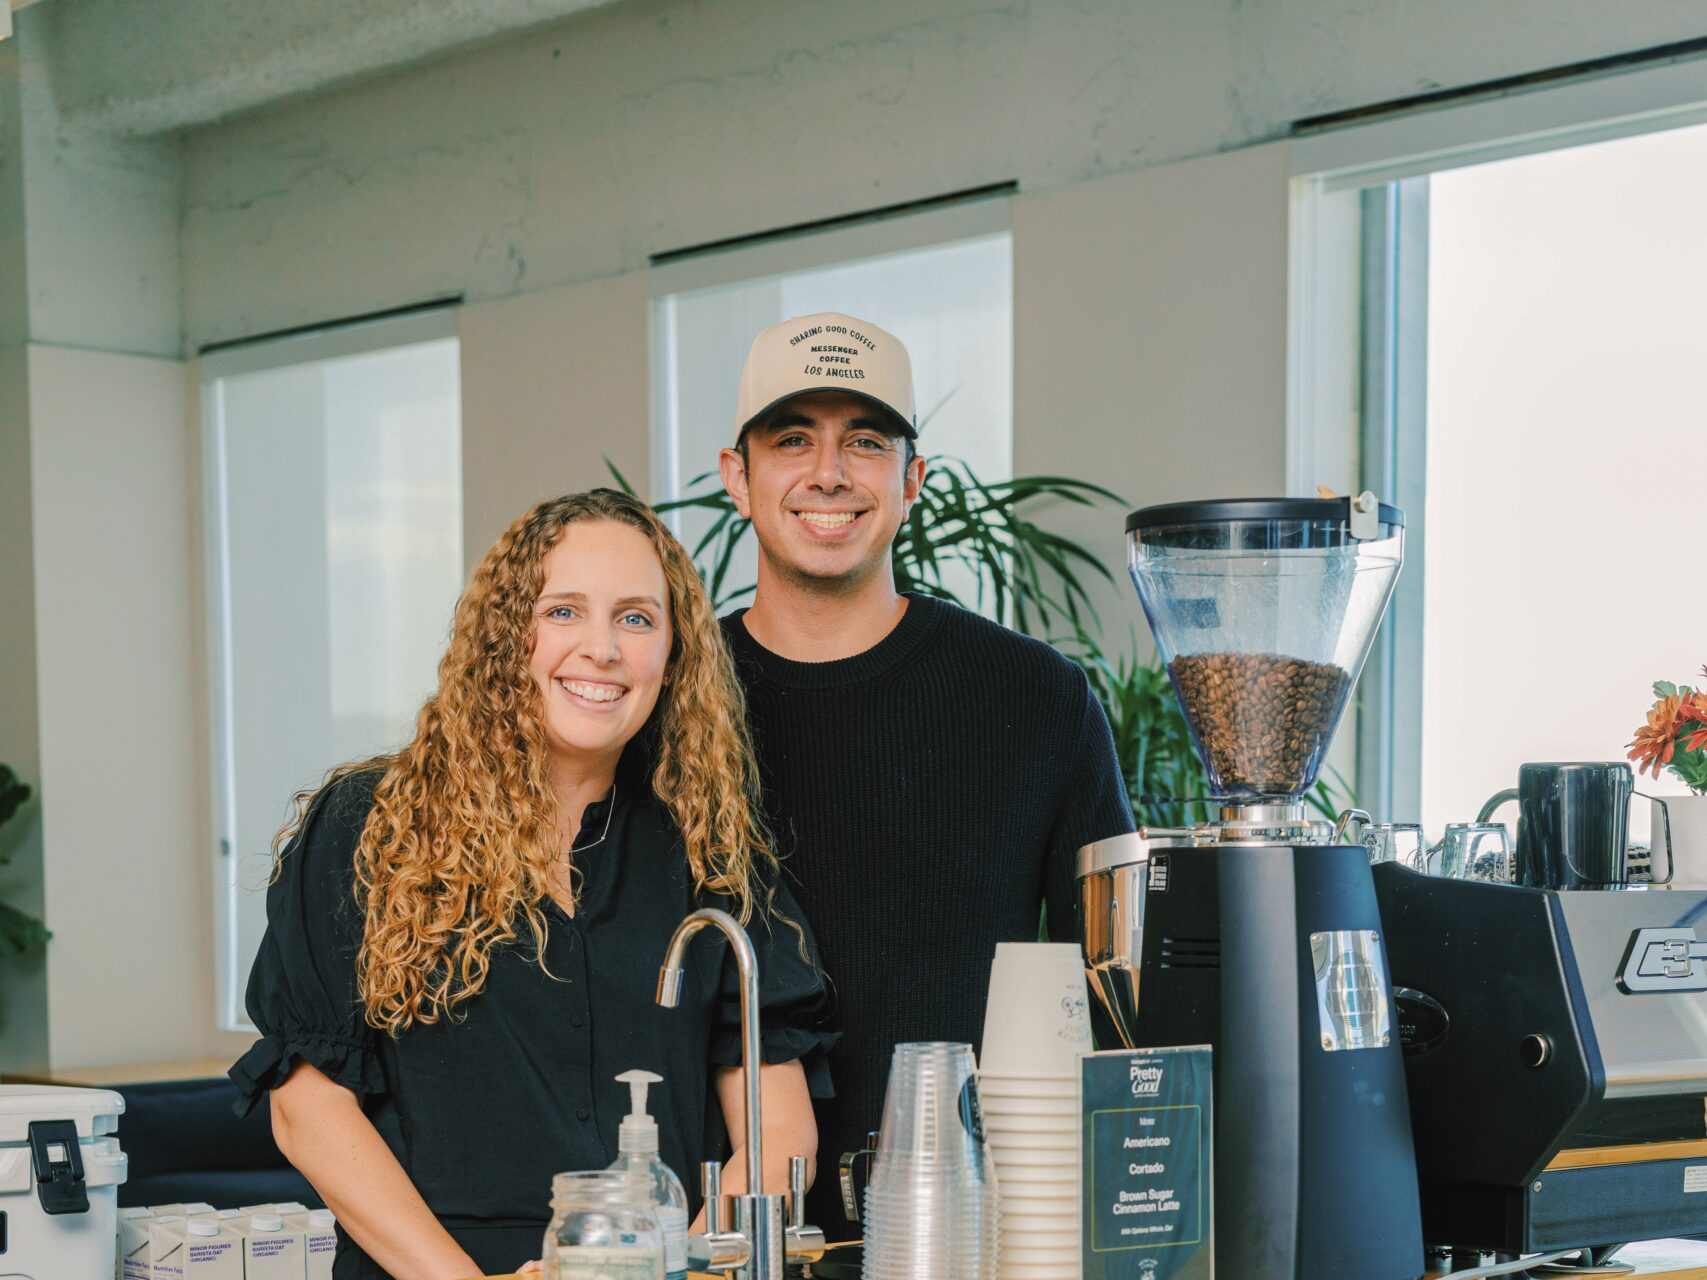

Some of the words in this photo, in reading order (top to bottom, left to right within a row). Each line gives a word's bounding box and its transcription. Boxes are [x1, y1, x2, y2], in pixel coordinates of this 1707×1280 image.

[789, 326, 823, 347] SHARING
[825, 325, 847, 335] GOOD
[849, 329, 877, 352] COFFEE
[810, 345, 859, 356] MESSENGER
[819, 355, 851, 365] COFFEE
[804, 364, 823, 376] LOS
[825, 367, 866, 379] ANGELES
[1130, 1066, 1163, 1081] Pretty
[1131, 1079, 1161, 1094] Good
[1123, 1136, 1171, 1149] Americano
[1129, 1162, 1165, 1175] Cortado
[1119, 1190, 1148, 1202] Brown
[1148, 1188, 1174, 1201] Sugar
[1112, 1203, 1157, 1215] Cinnamon
[1157, 1200, 1181, 1212] Latte
